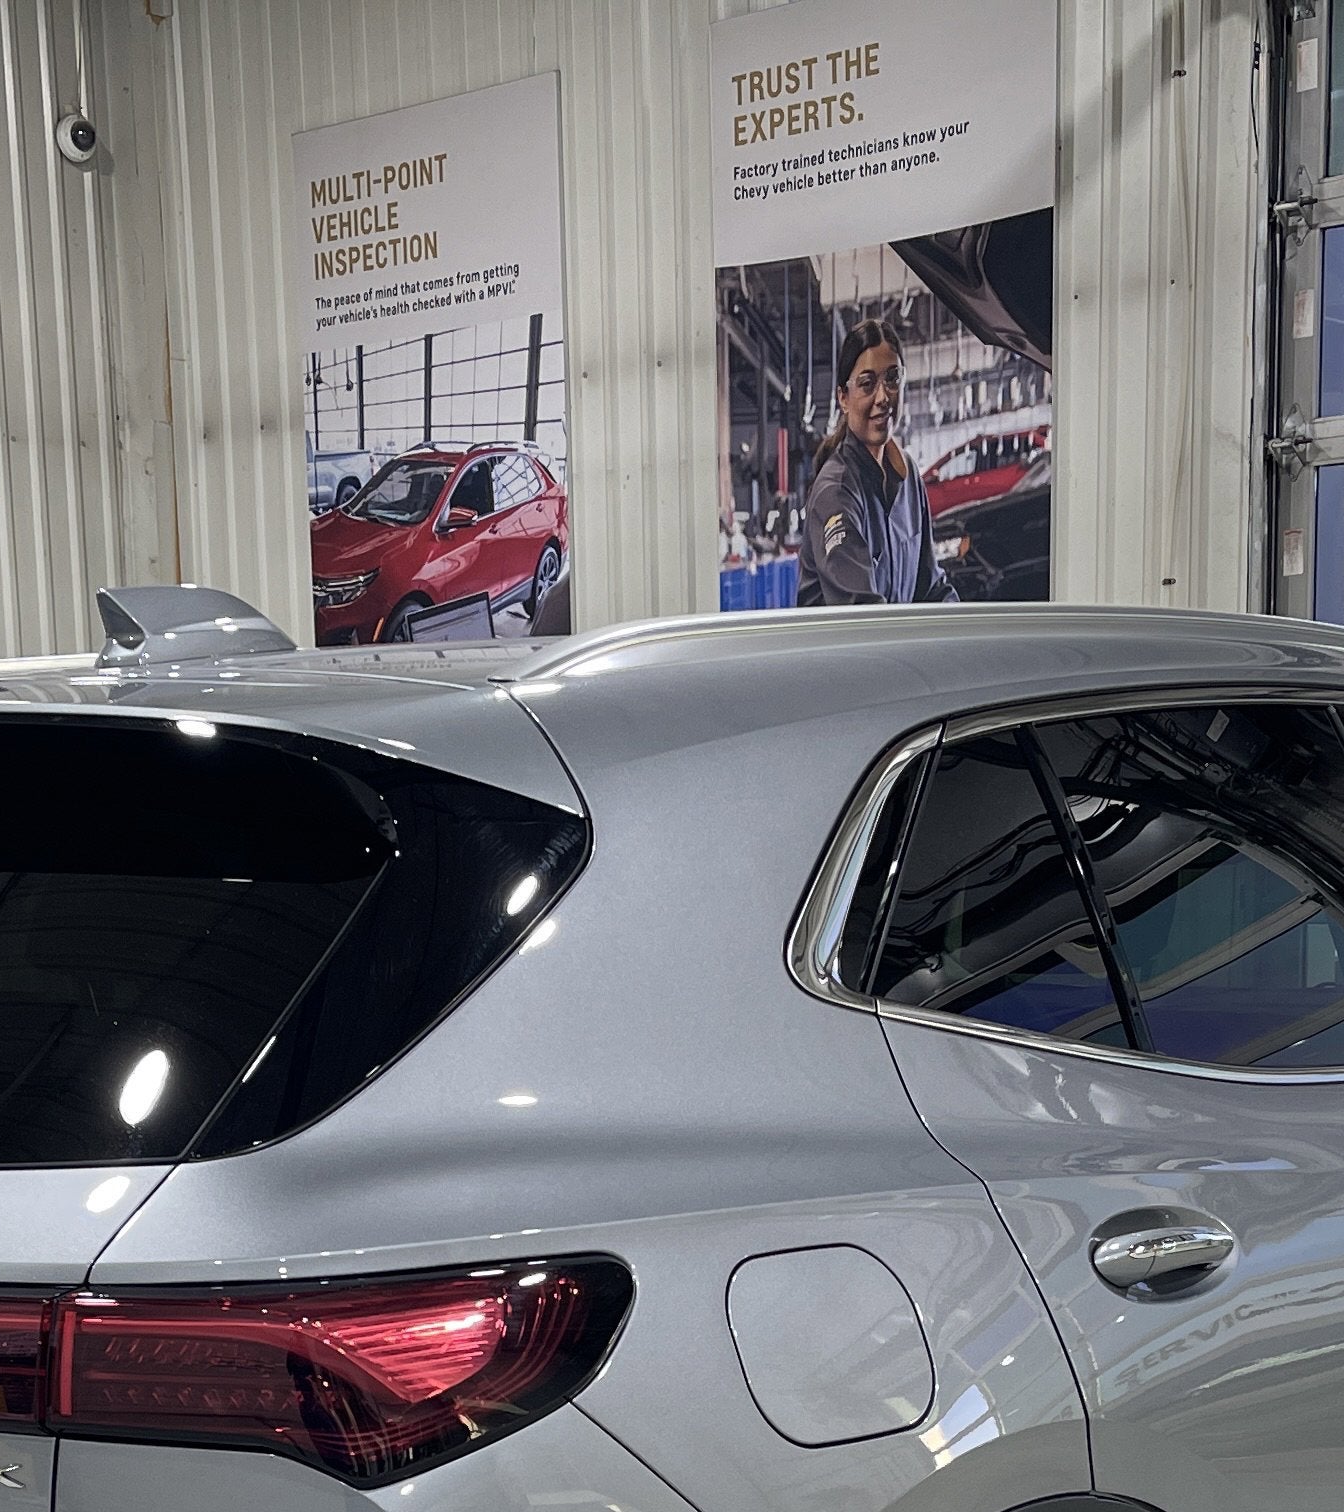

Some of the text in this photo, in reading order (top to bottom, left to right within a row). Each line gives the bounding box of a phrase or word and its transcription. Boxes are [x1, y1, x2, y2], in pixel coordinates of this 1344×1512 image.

[731, 42, 880, 106] TRUST THE
[733, 91, 865, 147] EXPERTS.
[733, 120, 970, 181] Factory trained technicians know your
[733, 150, 940, 201] Chevy vehicle better than anyone.
[310, 153, 447, 208] MULTI-POINT
[311, 201, 399, 244] VEHICLE
[314, 230, 438, 281] INSPECTION
[315, 262, 520, 311] The peace of mind that comes from getting
[316, 315, 337, 331] your
[339, 305, 378, 324] vehicle's
[380, 300, 410, 317] health
[412, 293, 452, 312] checked
[454, 289, 476, 305] with
[478, 290, 485, 301] a
